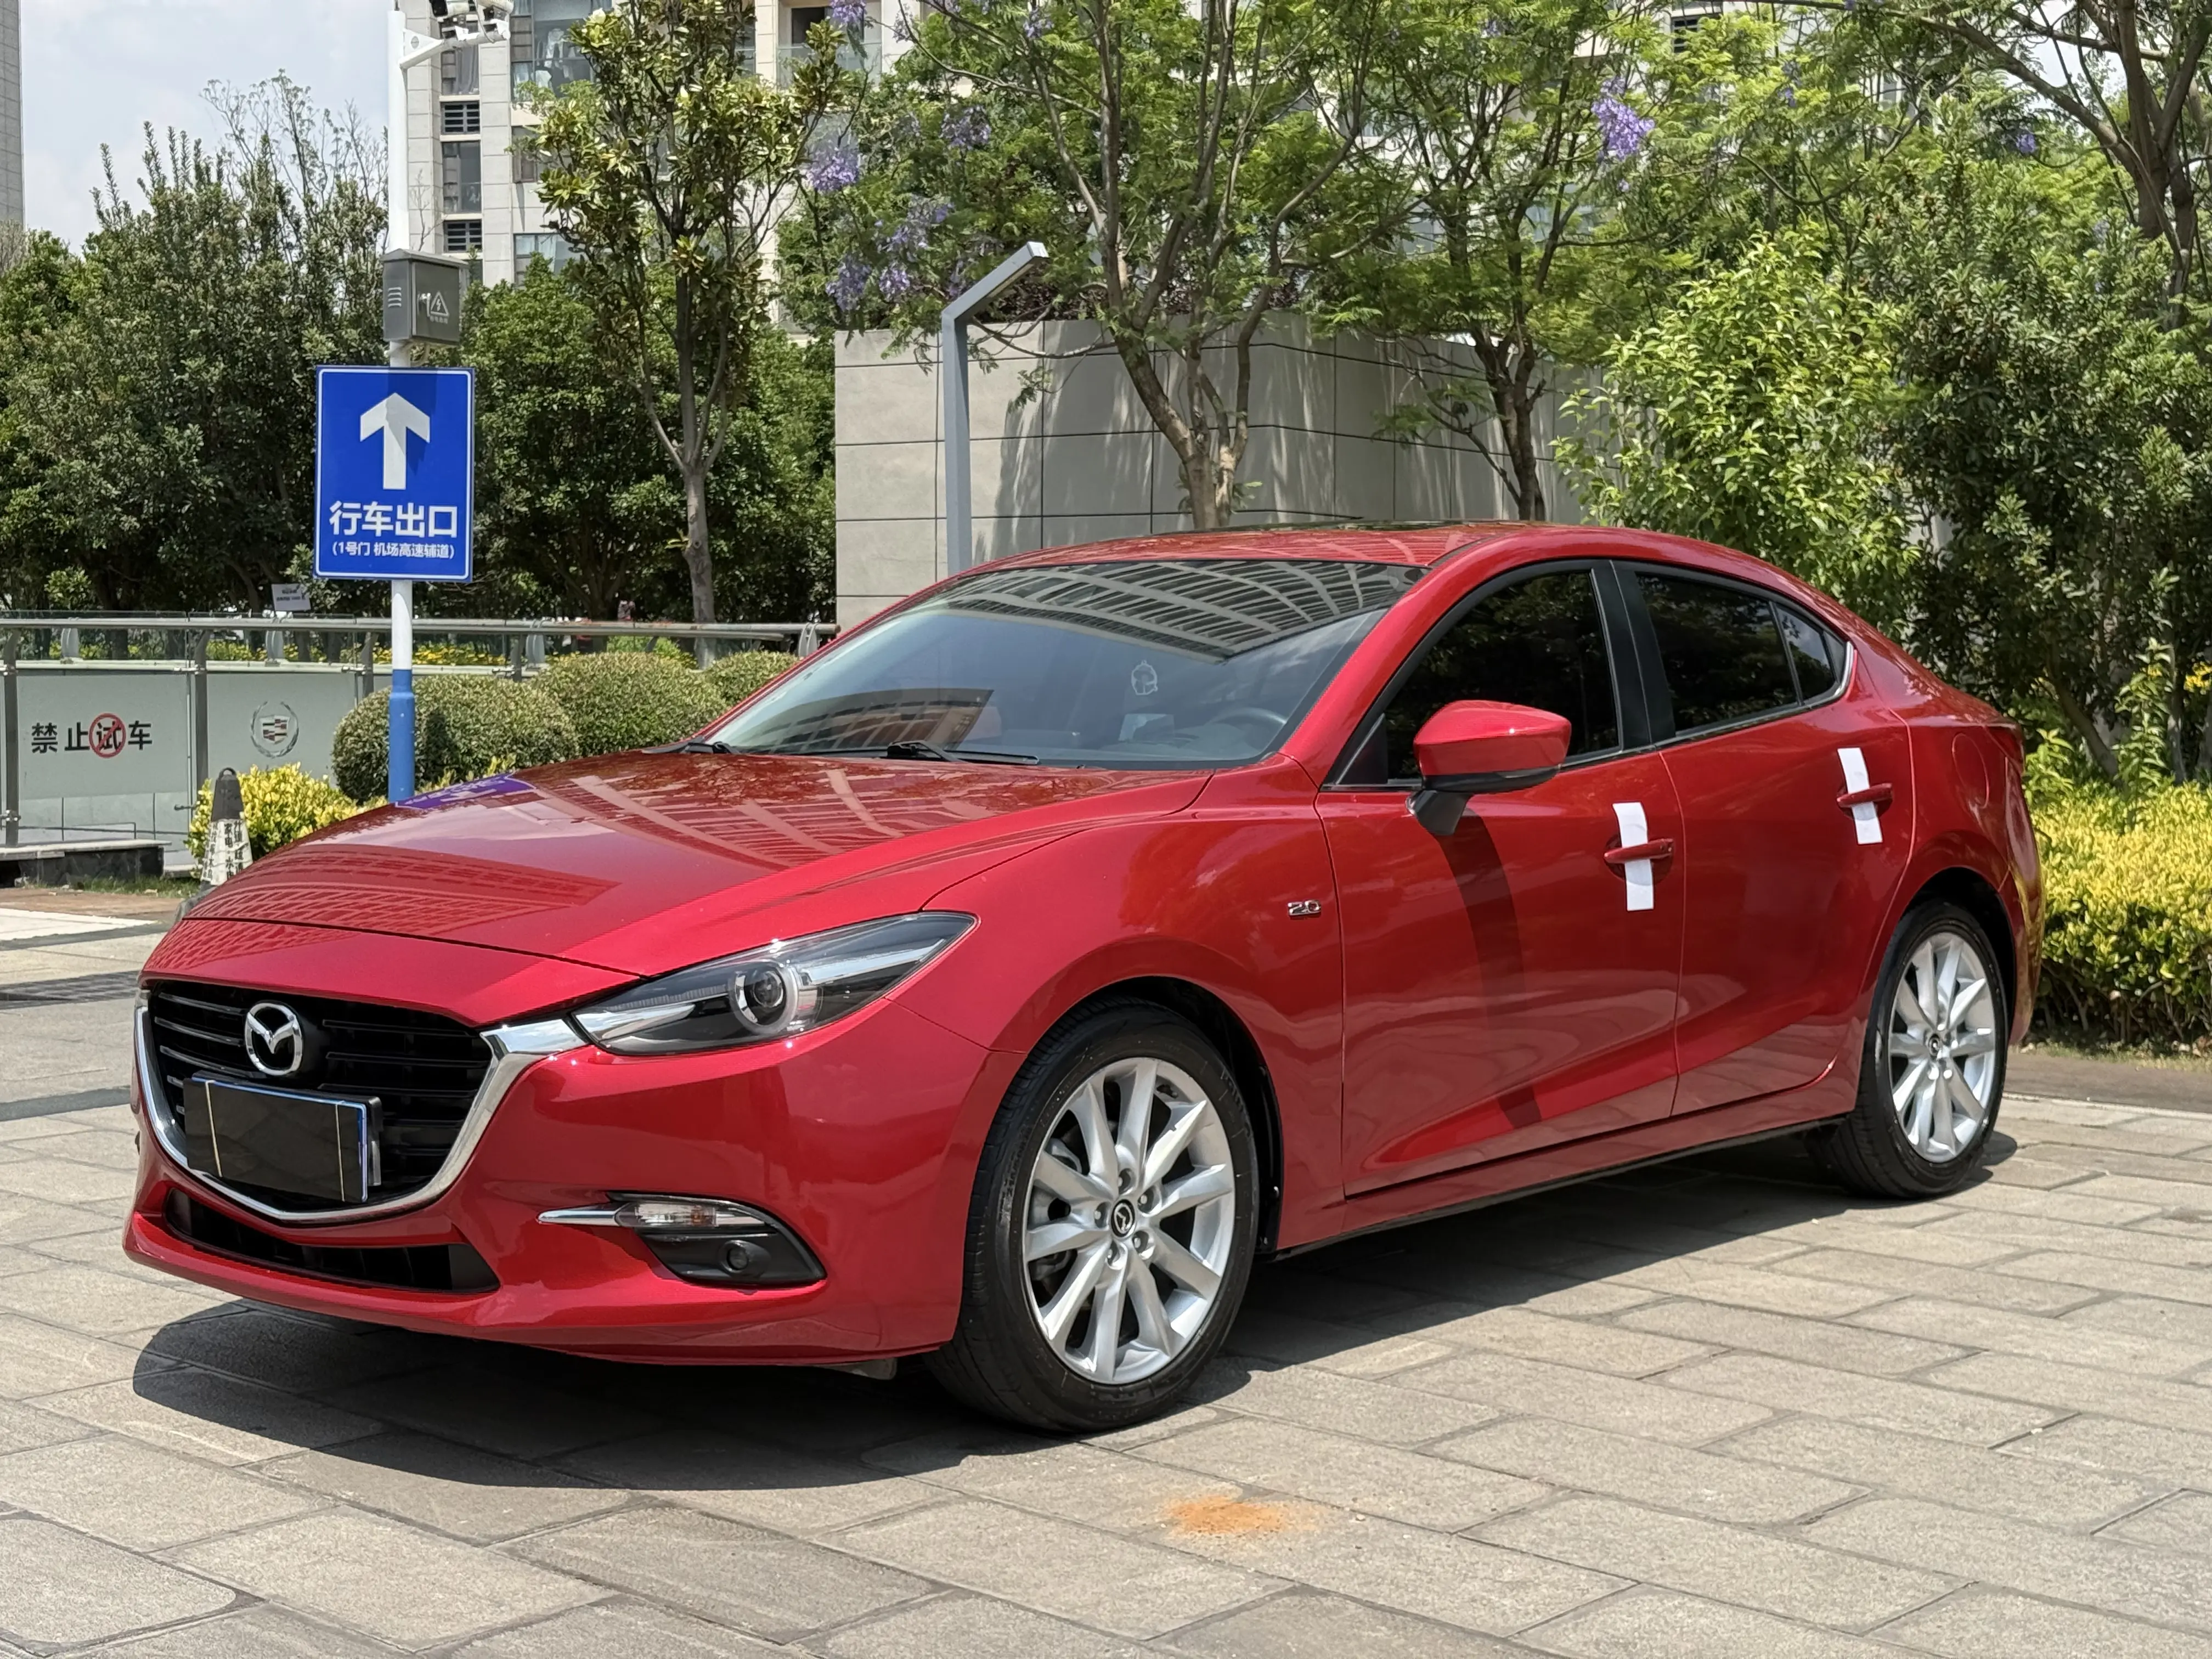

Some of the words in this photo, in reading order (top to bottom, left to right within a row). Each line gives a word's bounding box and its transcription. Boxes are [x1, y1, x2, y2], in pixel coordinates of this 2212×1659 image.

[329, 500, 458, 538] 行车出口
[332, 541, 370, 556] (1号门
[31, 720, 153, 753] 禁止试车
